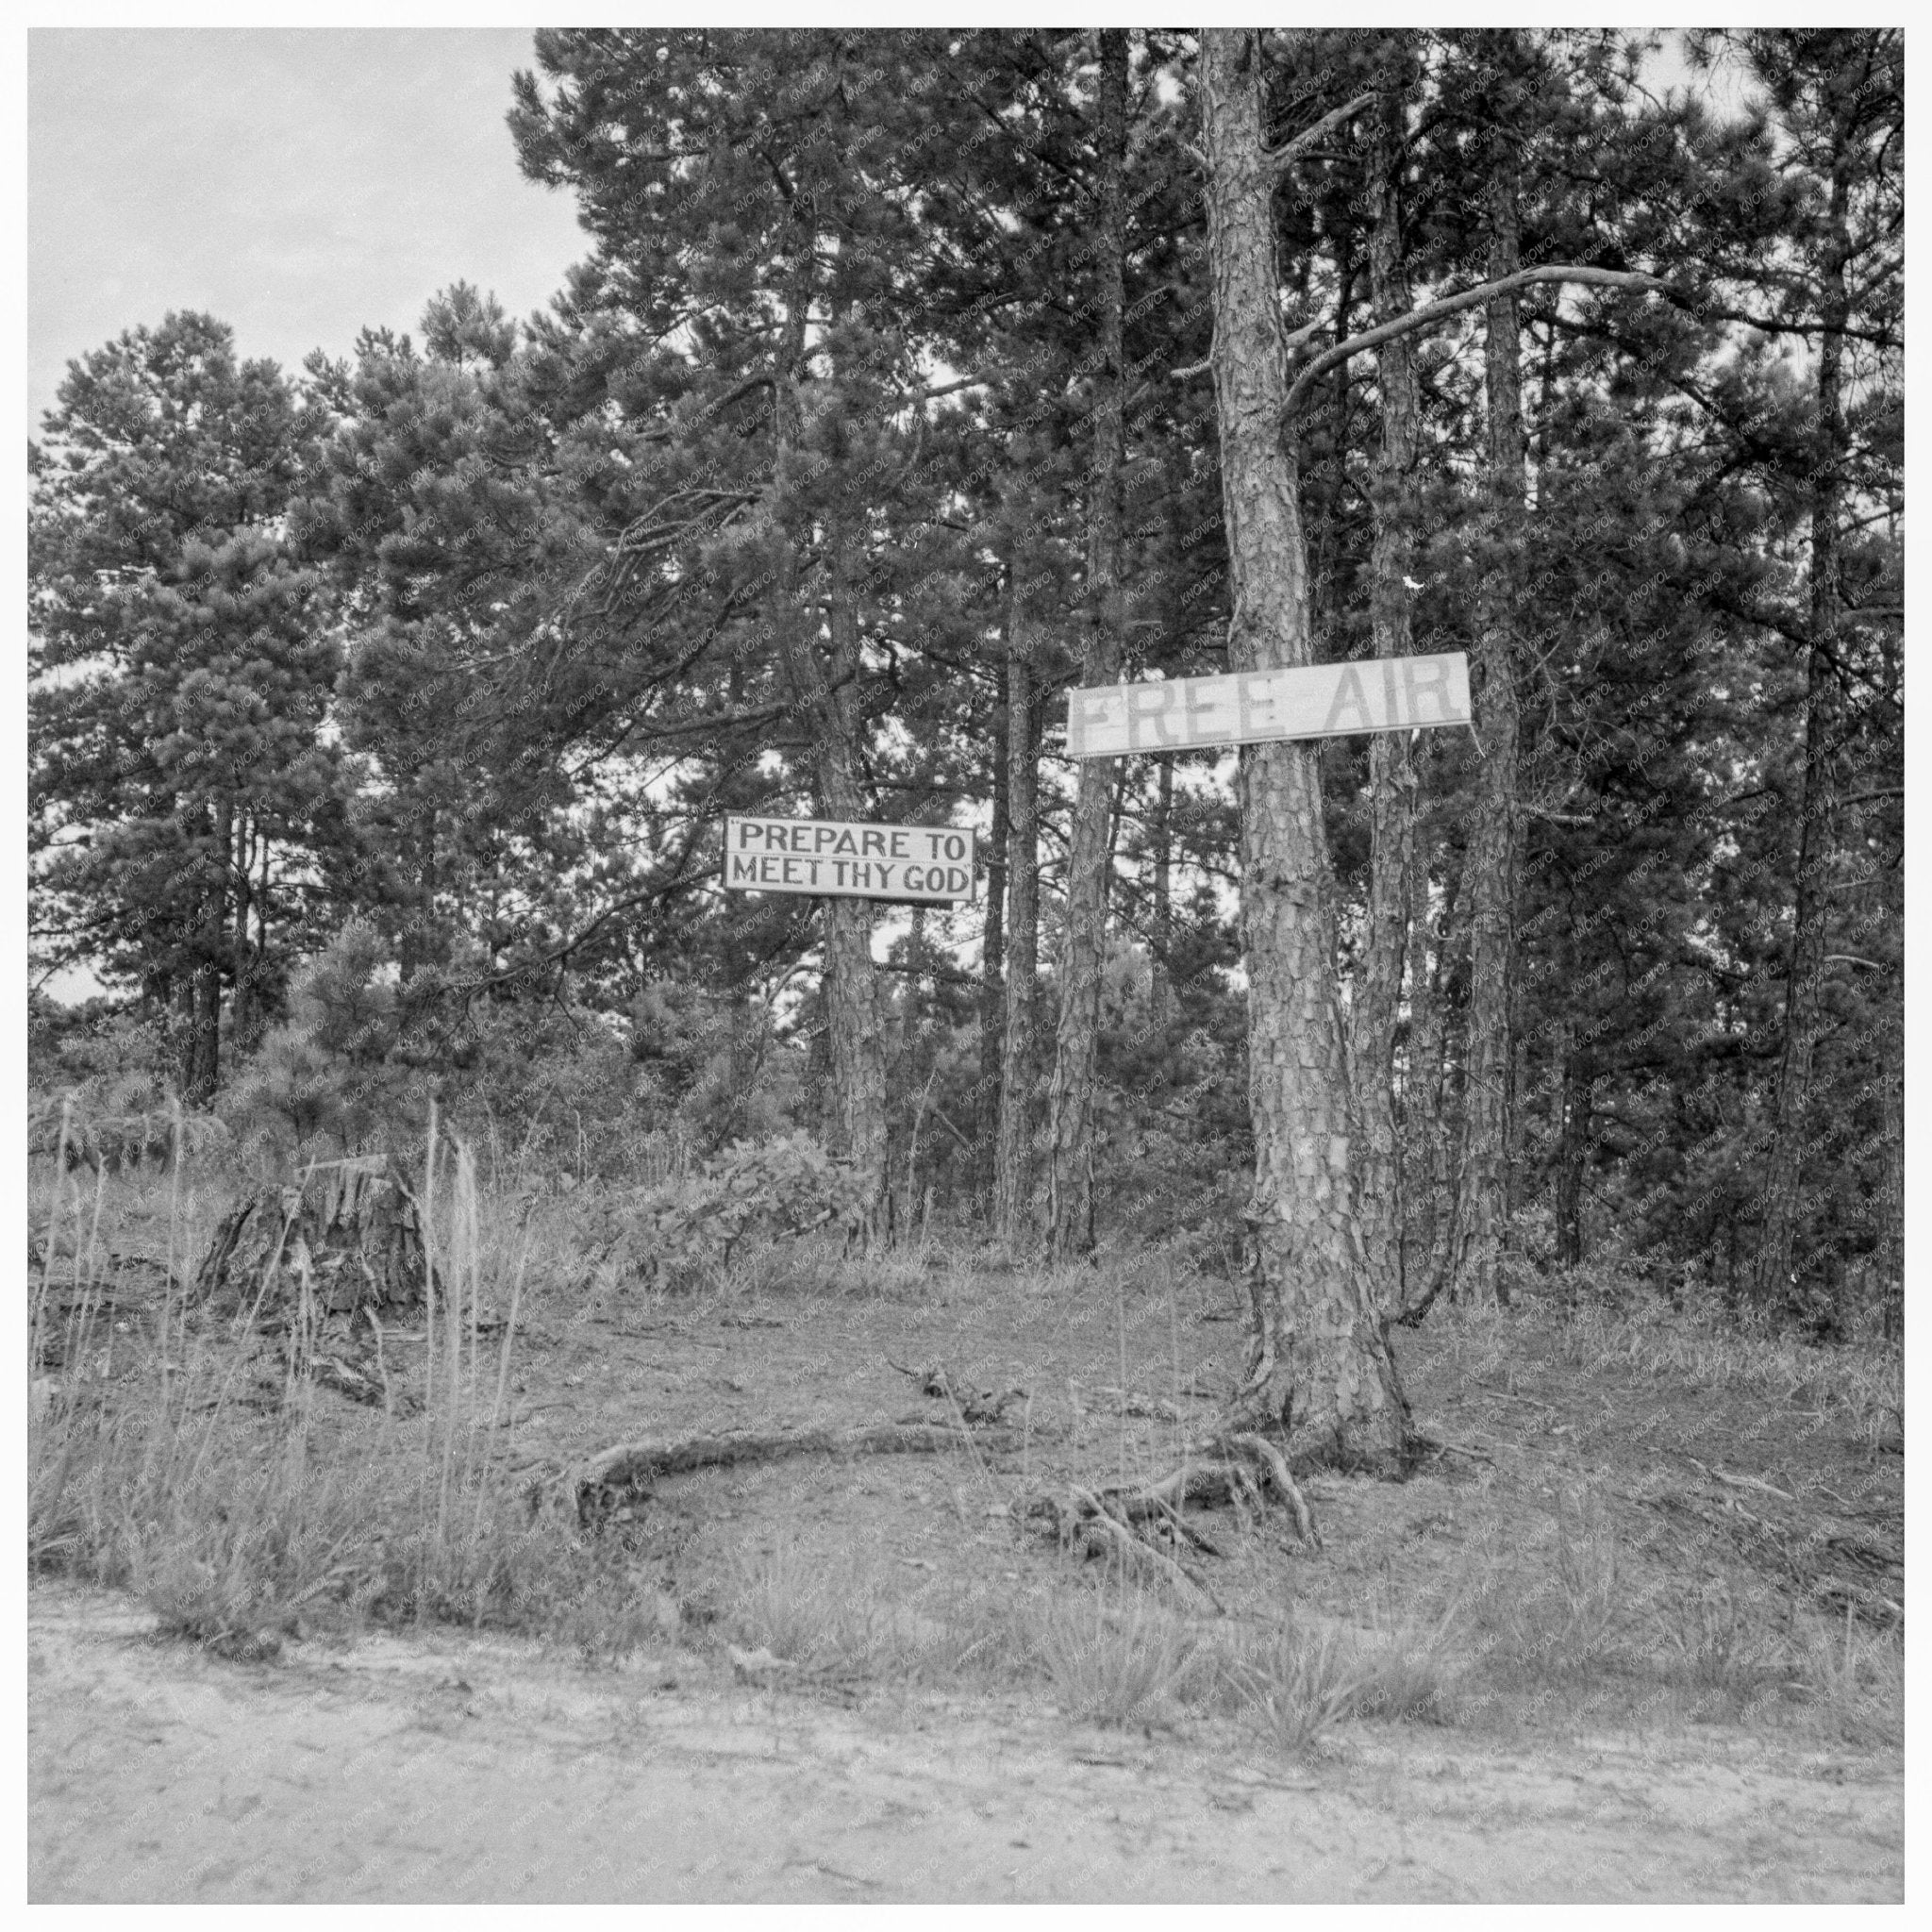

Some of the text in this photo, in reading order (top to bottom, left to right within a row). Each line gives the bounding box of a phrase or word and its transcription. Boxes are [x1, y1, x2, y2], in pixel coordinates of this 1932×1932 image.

[1072, 656, 1461, 753] FREE AIR
[926, 834, 966, 861] TO
[734, 855, 824, 886] MEET
[832, 860, 895, 890] THY
